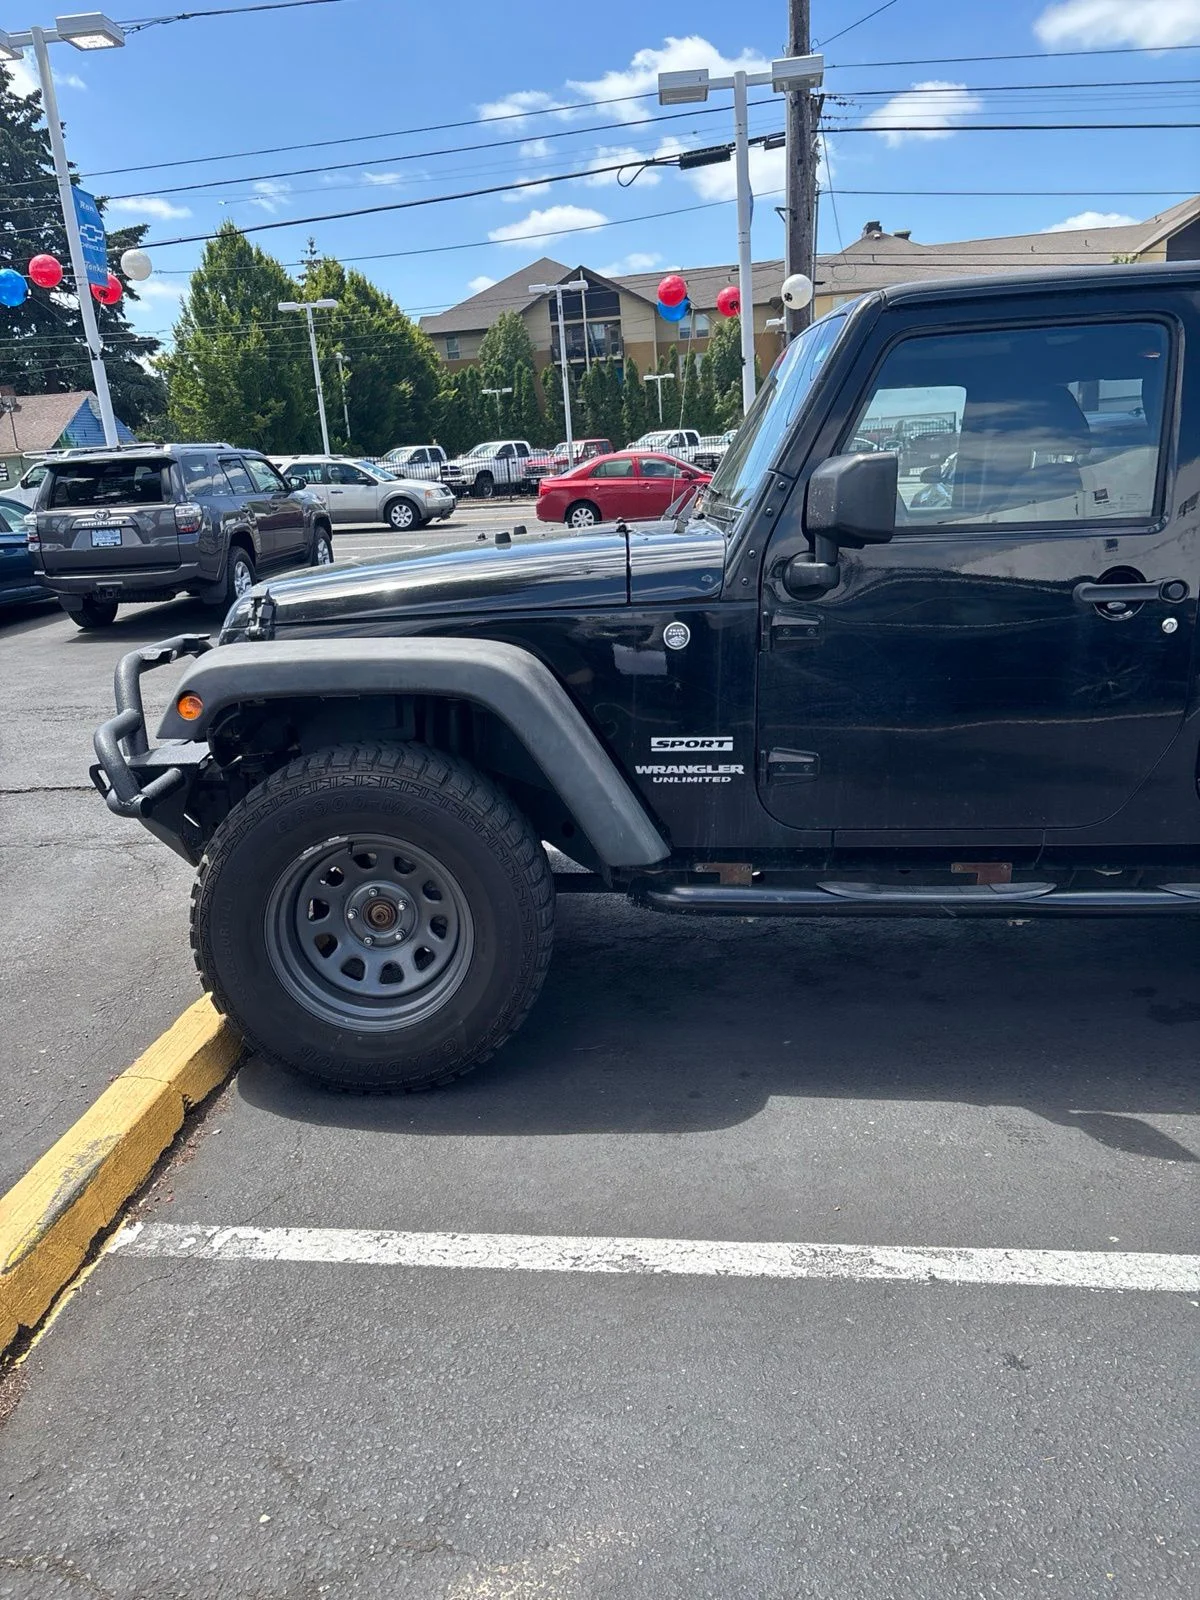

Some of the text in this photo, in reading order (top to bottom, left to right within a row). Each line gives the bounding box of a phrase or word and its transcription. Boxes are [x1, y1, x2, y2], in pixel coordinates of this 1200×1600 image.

[80, 200, 95, 212] Ron
[651, 738, 733, 750] SPORT
[635, 764, 744, 774] WRANGLER
